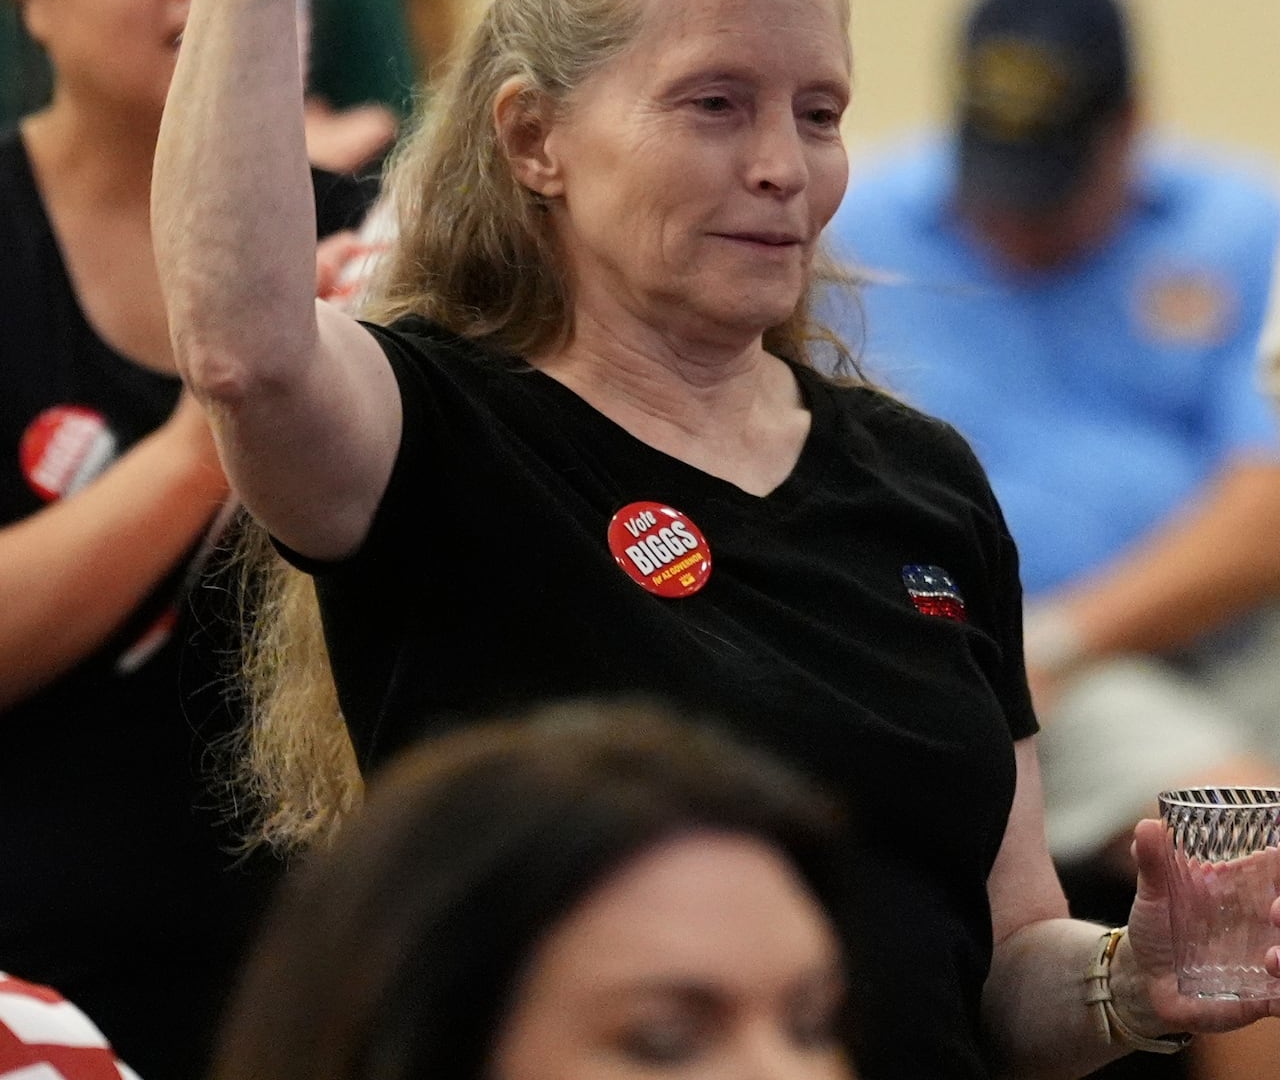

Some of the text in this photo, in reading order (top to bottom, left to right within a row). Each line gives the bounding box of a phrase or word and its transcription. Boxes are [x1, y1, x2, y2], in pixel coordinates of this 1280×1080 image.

[623, 510, 657, 538] Vote
[624, 520, 699, 576] BIGGS
[669, 552, 704, 575] GOVERNOR
